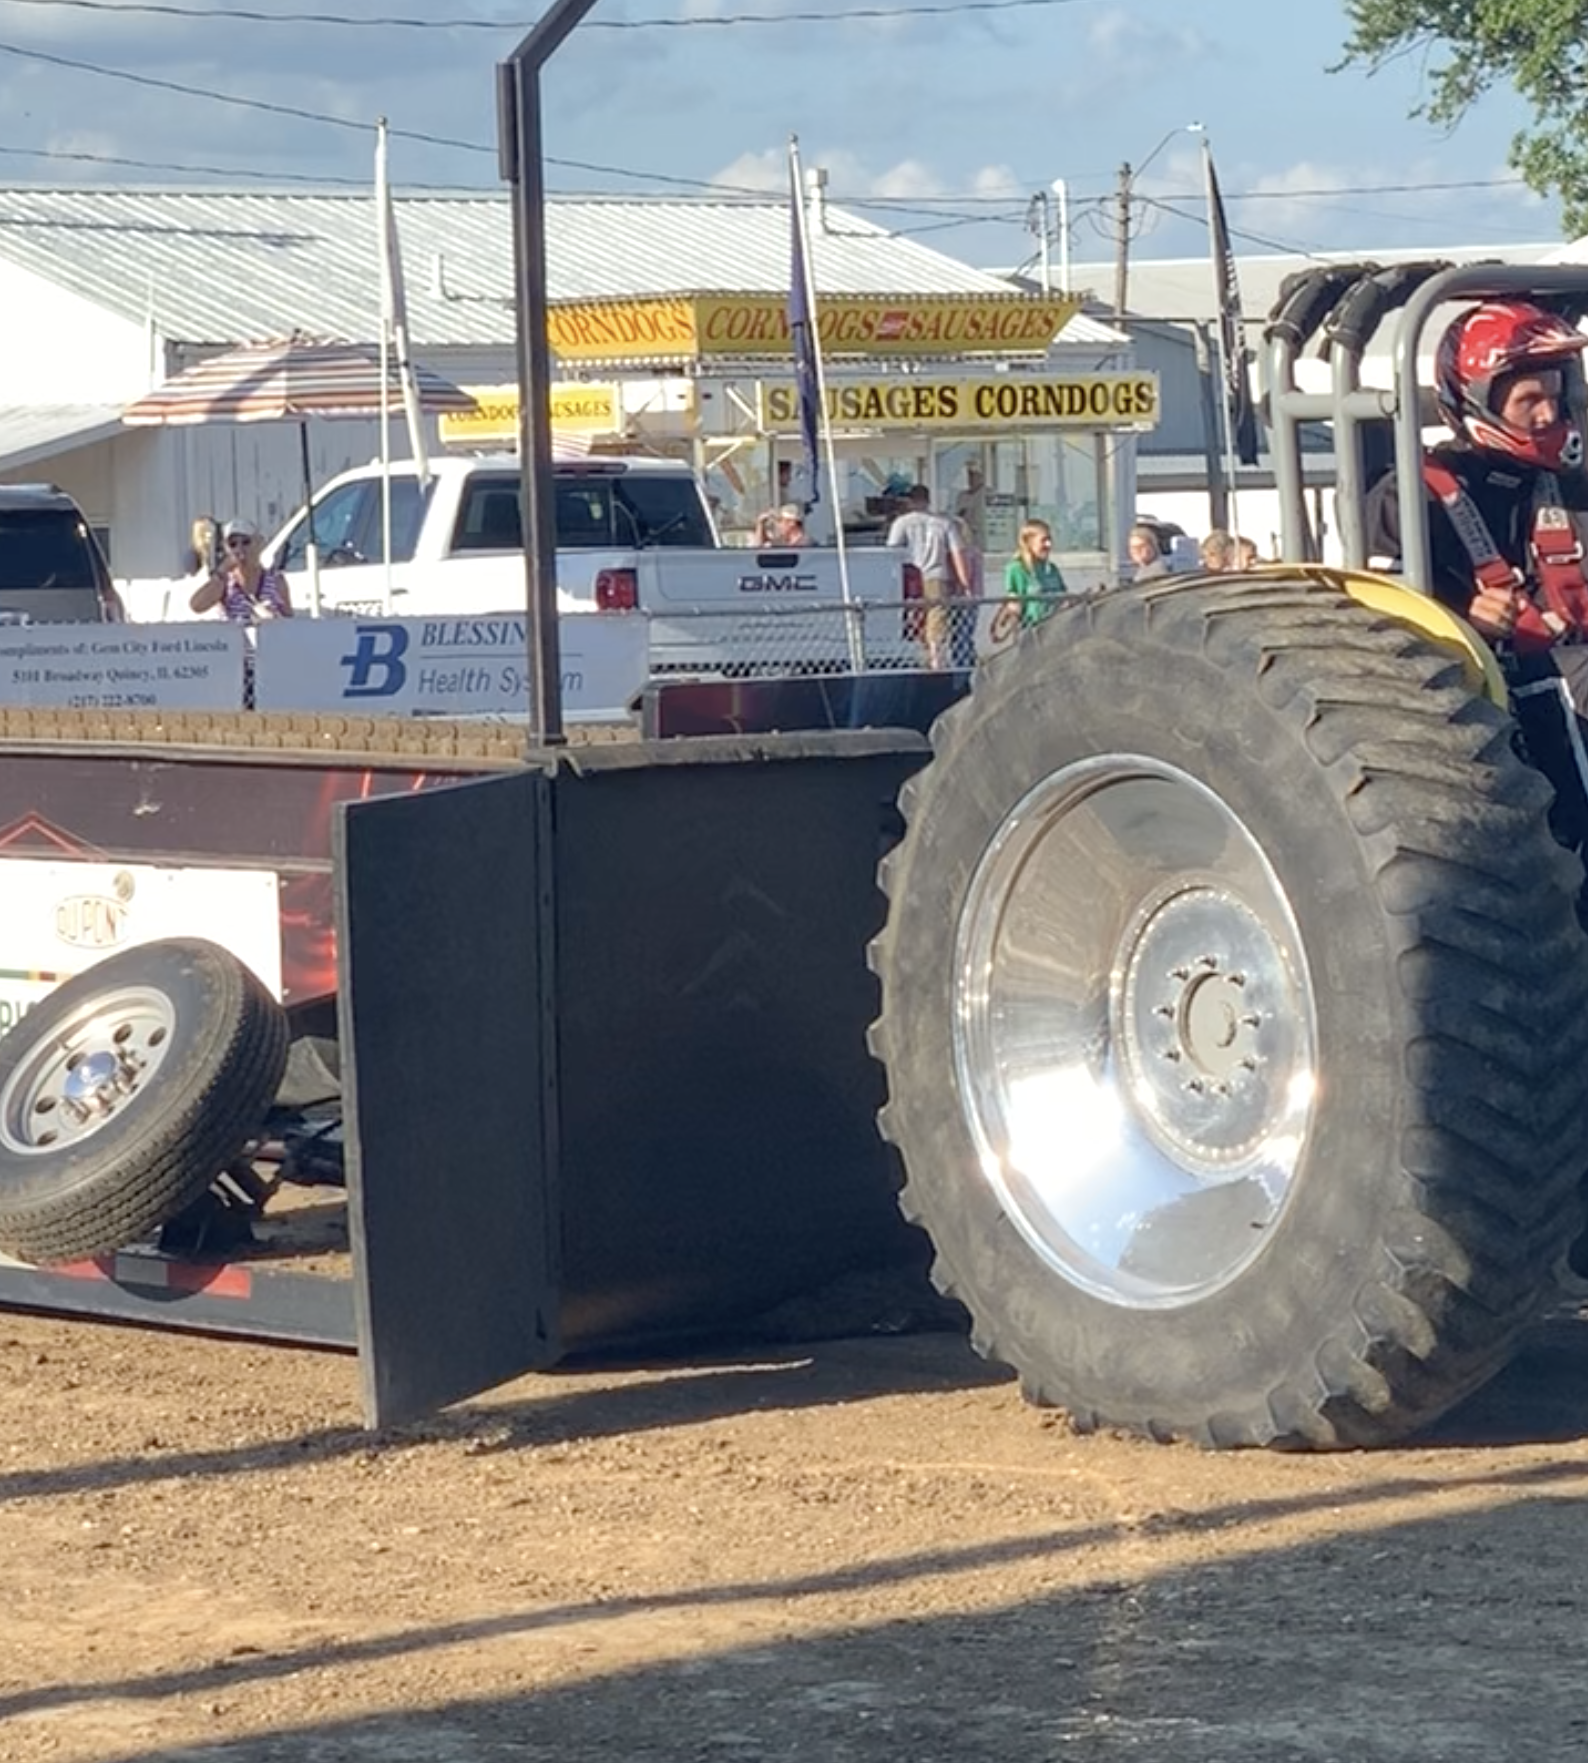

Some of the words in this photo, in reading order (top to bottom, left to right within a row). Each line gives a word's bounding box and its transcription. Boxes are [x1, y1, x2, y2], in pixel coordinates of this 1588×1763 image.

[706, 306, 878, 342] CORNOGS
[903, 306, 1062, 342] SAUSAGES
[975, 380, 1156, 418] CORNDOGS
[739, 575, 818, 592] GMC
[421, 620, 527, 647] BLESSIN
[0, 644, 69, 659] ompliments
[123, 641, 147, 655] City
[44, 669, 102, 685] Broadway
[418, 668, 490, 694] Health
